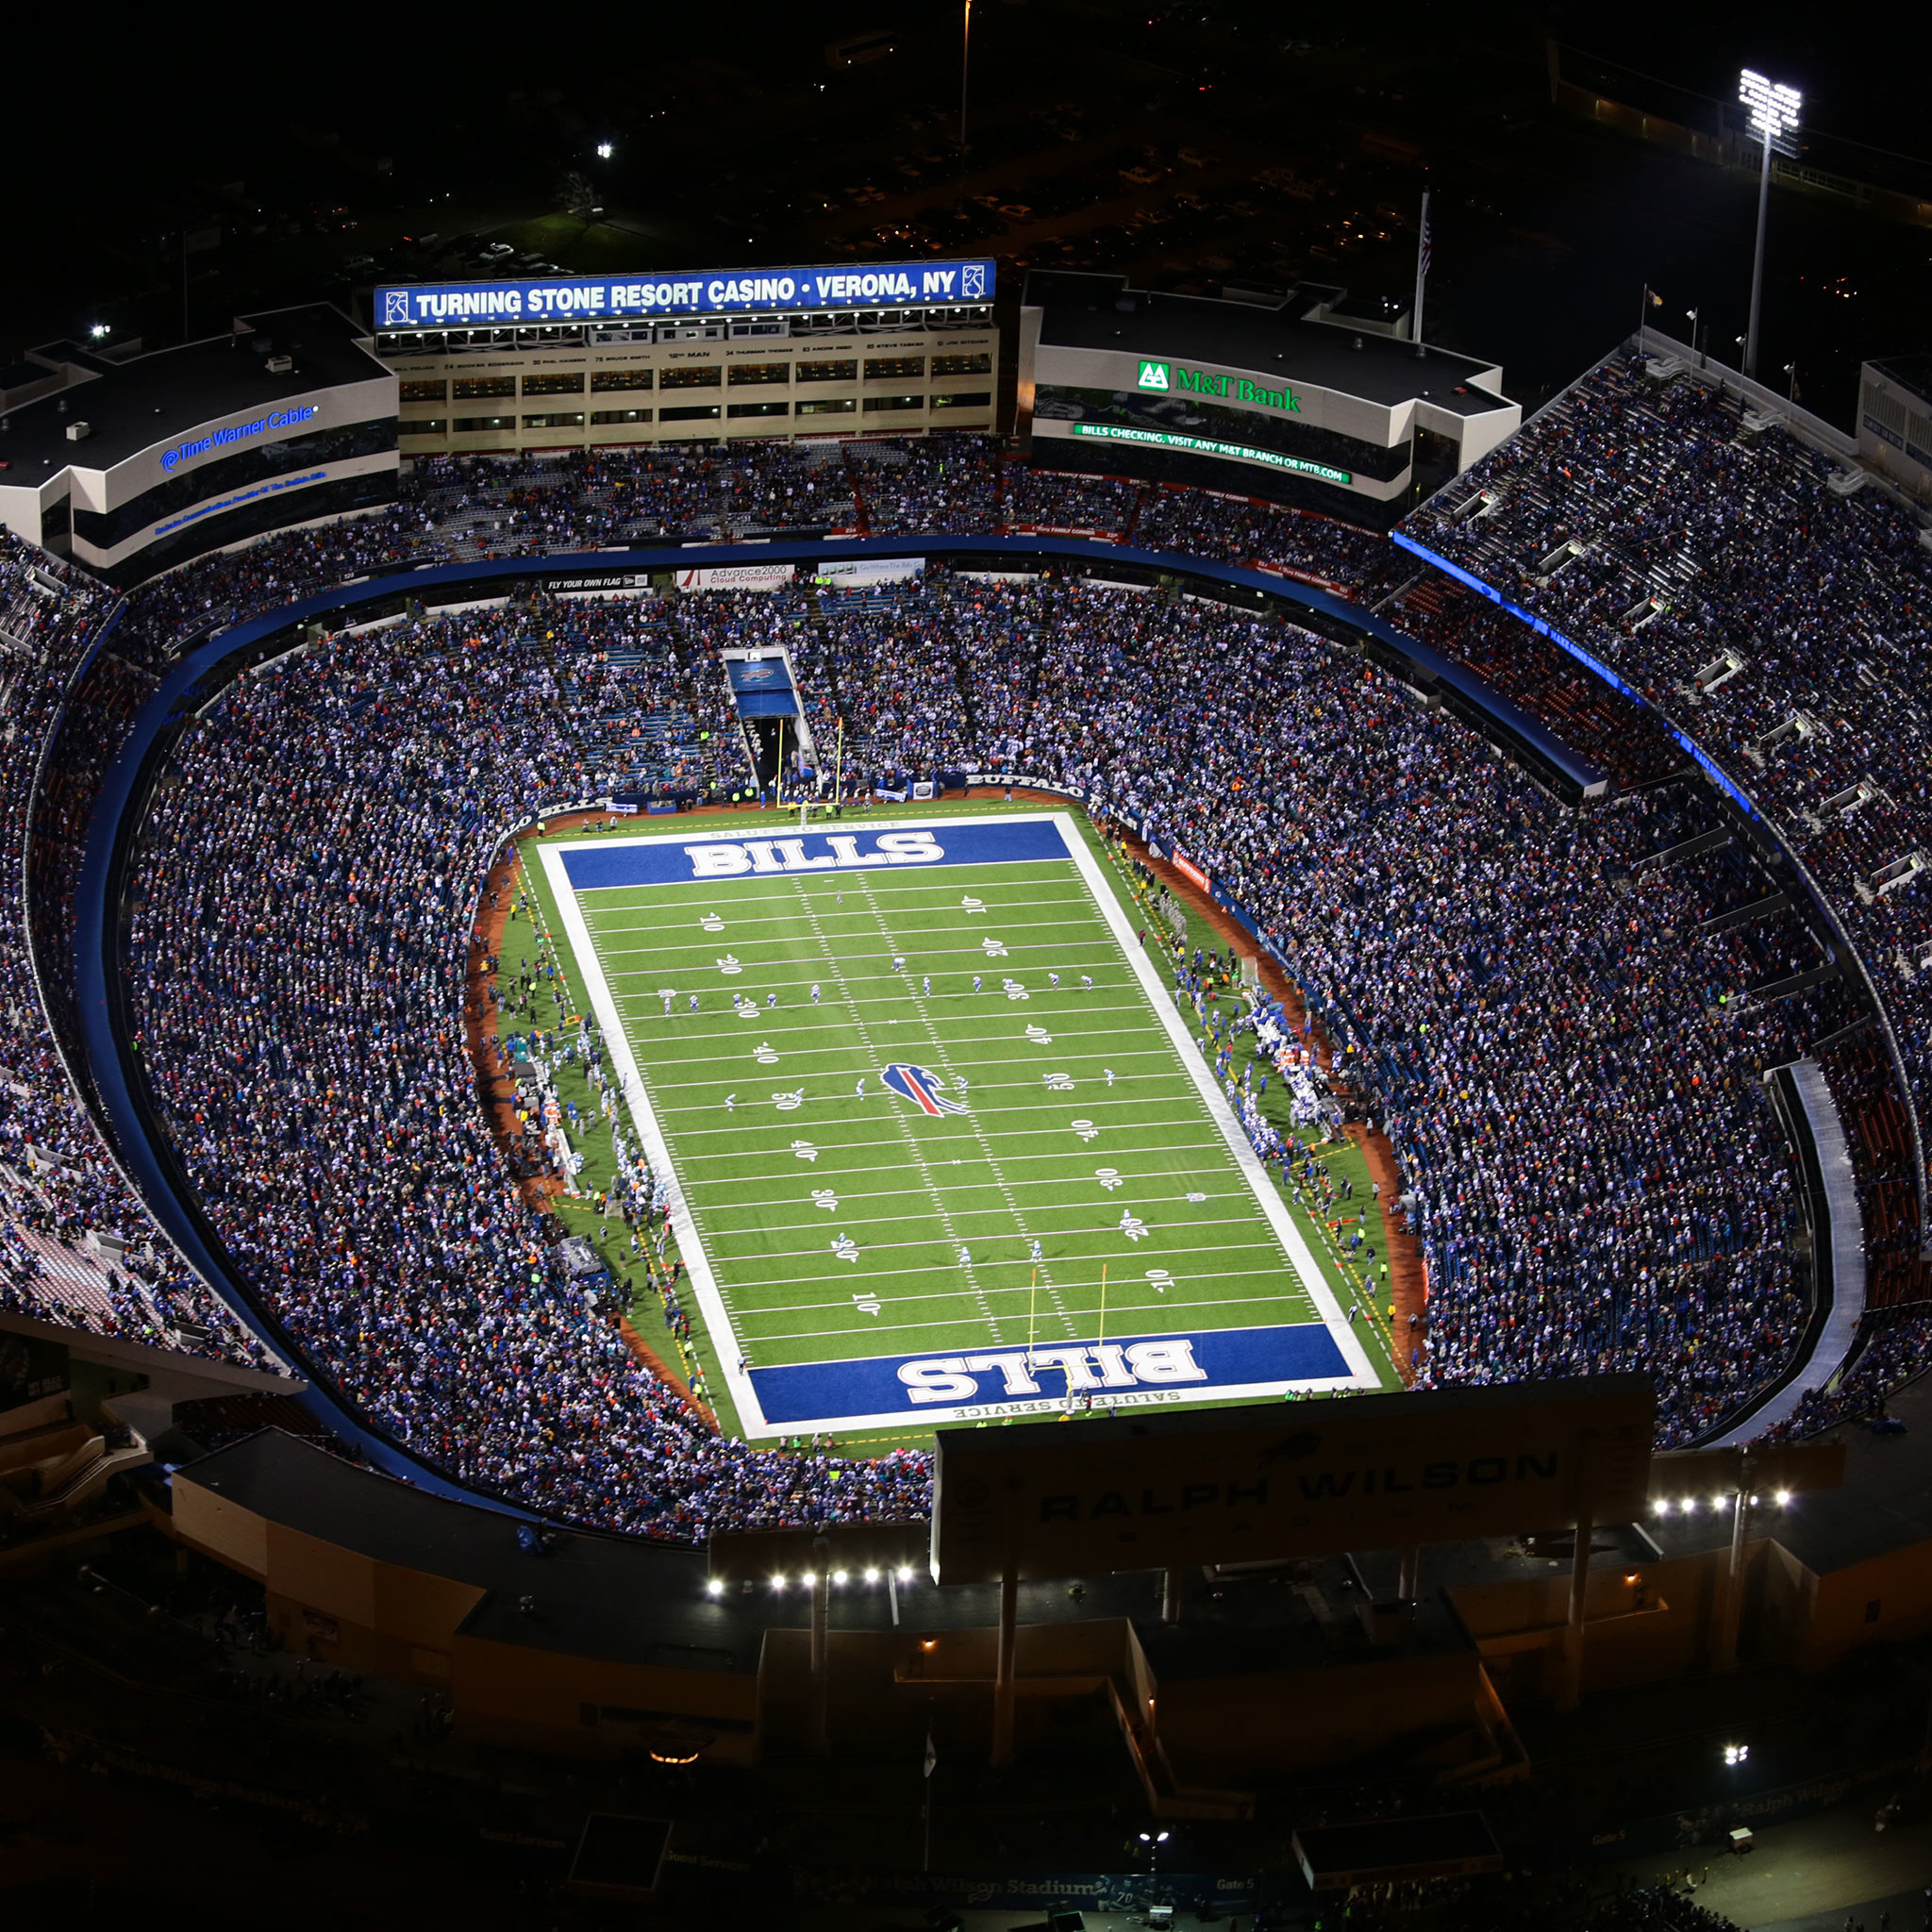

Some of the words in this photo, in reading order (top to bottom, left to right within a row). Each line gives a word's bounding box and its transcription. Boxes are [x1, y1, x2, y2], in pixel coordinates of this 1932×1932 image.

[416, 291, 521, 317] TURNING
[527, 286, 605, 310] STONE
[611, 282, 703, 308] RESORT
[708, 277, 795, 303] CASINO
[815, 273, 916, 299] VERONA,
[923, 271, 956, 292] NY
[1176, 368, 1234, 397] M&T
[1238, 379, 1301, 413] Bank
[178, 438, 213, 460] Time
[212, 418, 267, 447] Warner
[268, 407, 313, 429] Cable
[1082, 425, 1108, 437] BILLS
[1168, 435, 1193, 447] VISIT
[1195, 439, 1217, 452] ANY
[1219, 443, 1241, 457] M&T
[1242, 448, 1283, 466] BRANCH
[1284, 458, 1298, 469] OR
[711, 566, 787, 577] Advance2000
[739, 575, 787, 583] Computing
[563, 579, 584, 588] YOUR
[585, 578, 603, 587] OWN
[604, 577, 622, 586] FLAG
[965, 774, 1084, 798] BUFFALO
[538, 797, 613, 819] BILLS
[710, 828, 789, 840] SALUTE
[790, 825, 813, 834] TO
[818, 822, 901, 832] SERVICE
[684, 831, 944, 876] BILLS
[1025, 1027, 1052, 1044] 40
[753, 1047, 779, 1064] 40
[1071, 1120, 1099, 1139] 40
[791, 1140, 818, 1158] 40
[1095, 1168, 1124, 1187] 30
[811, 1189, 839, 1208] 30
[1145, 1269, 1175, 1288] 10
[853, 1291, 881, 1311] 10
[897, 1340, 1208, 1404] BILLS
[1095, 1391, 1181, 1407] SALUTE
[955, 1401, 1053, 1418] SERVICE
[1040, 1476, 1269, 1524] RALPH
[1297, 1451, 1559, 1500] WILSON
[664, 1849, 698, 1865] Guest
[700, 1855, 751, 1873] Services
[1007, 1879, 1095, 1895] Stadium
[1216, 1878, 1244, 1890] Gate
[1247, 1877, 1255, 1890] 5
[1116, 1890, 1134, 1905] 70
